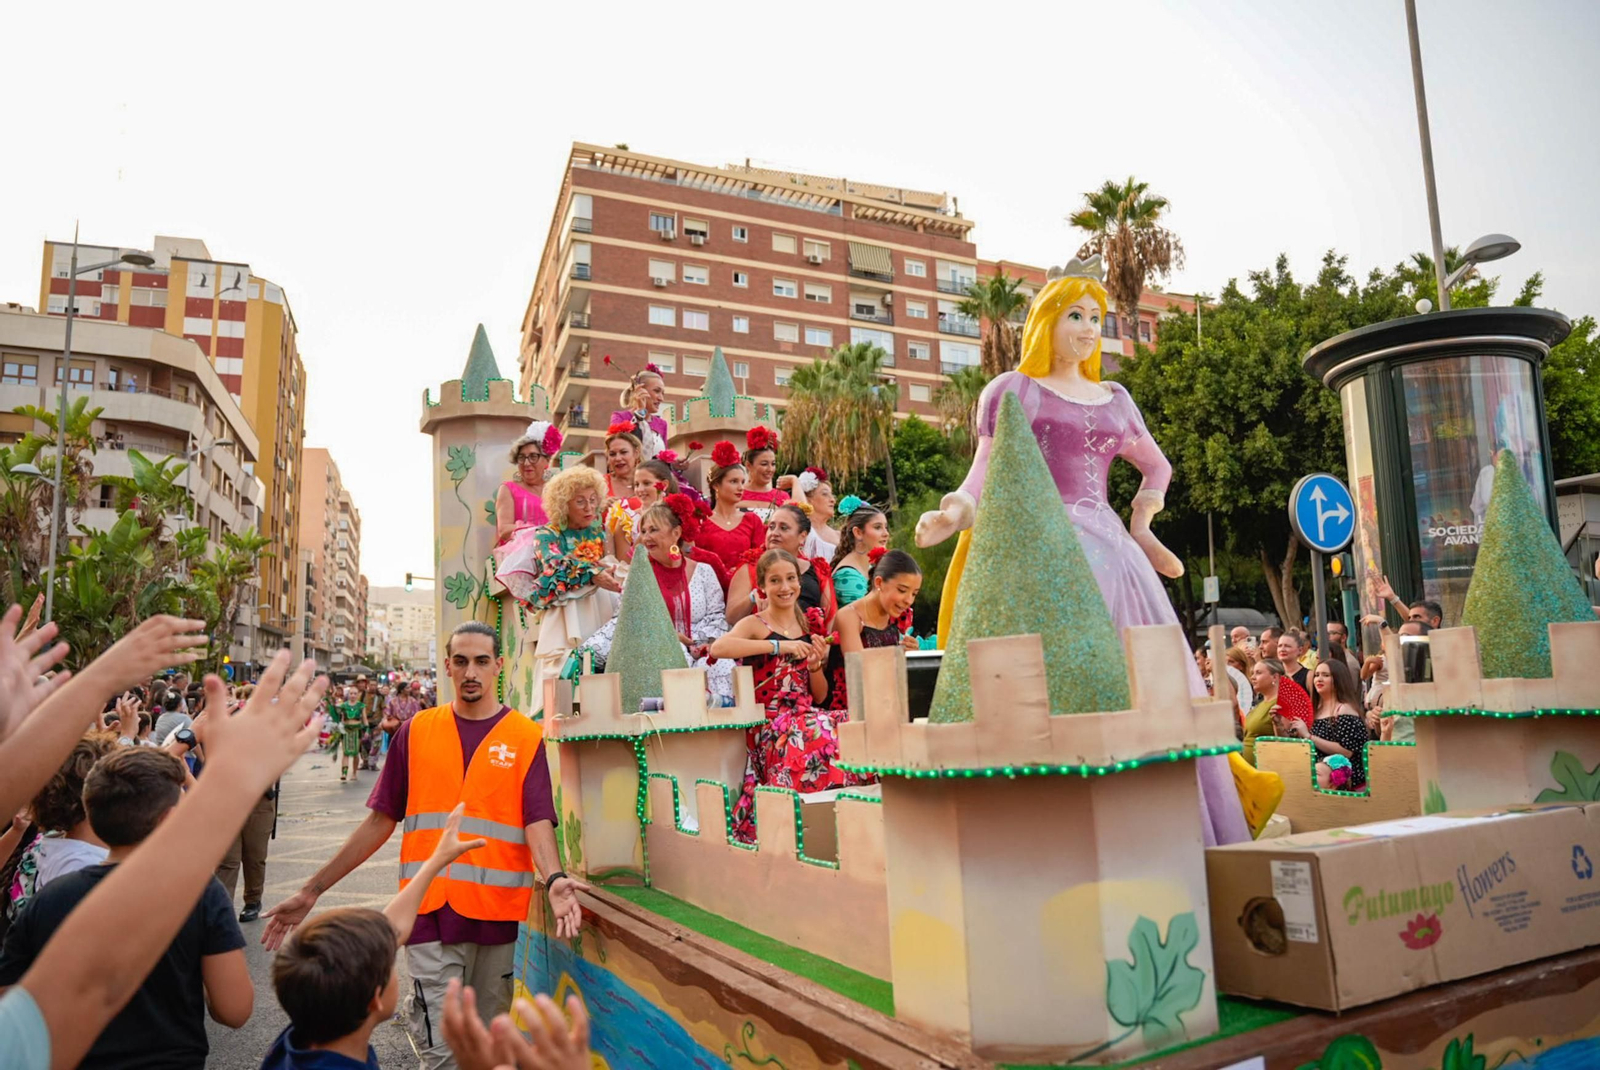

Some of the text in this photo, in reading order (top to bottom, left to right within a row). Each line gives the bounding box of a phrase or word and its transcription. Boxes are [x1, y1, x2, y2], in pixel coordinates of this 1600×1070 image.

[1444, 535, 1482, 546] AVAN
[1342, 880, 1455, 926] Putumayo
[1457, 851, 1516, 919] flowers
